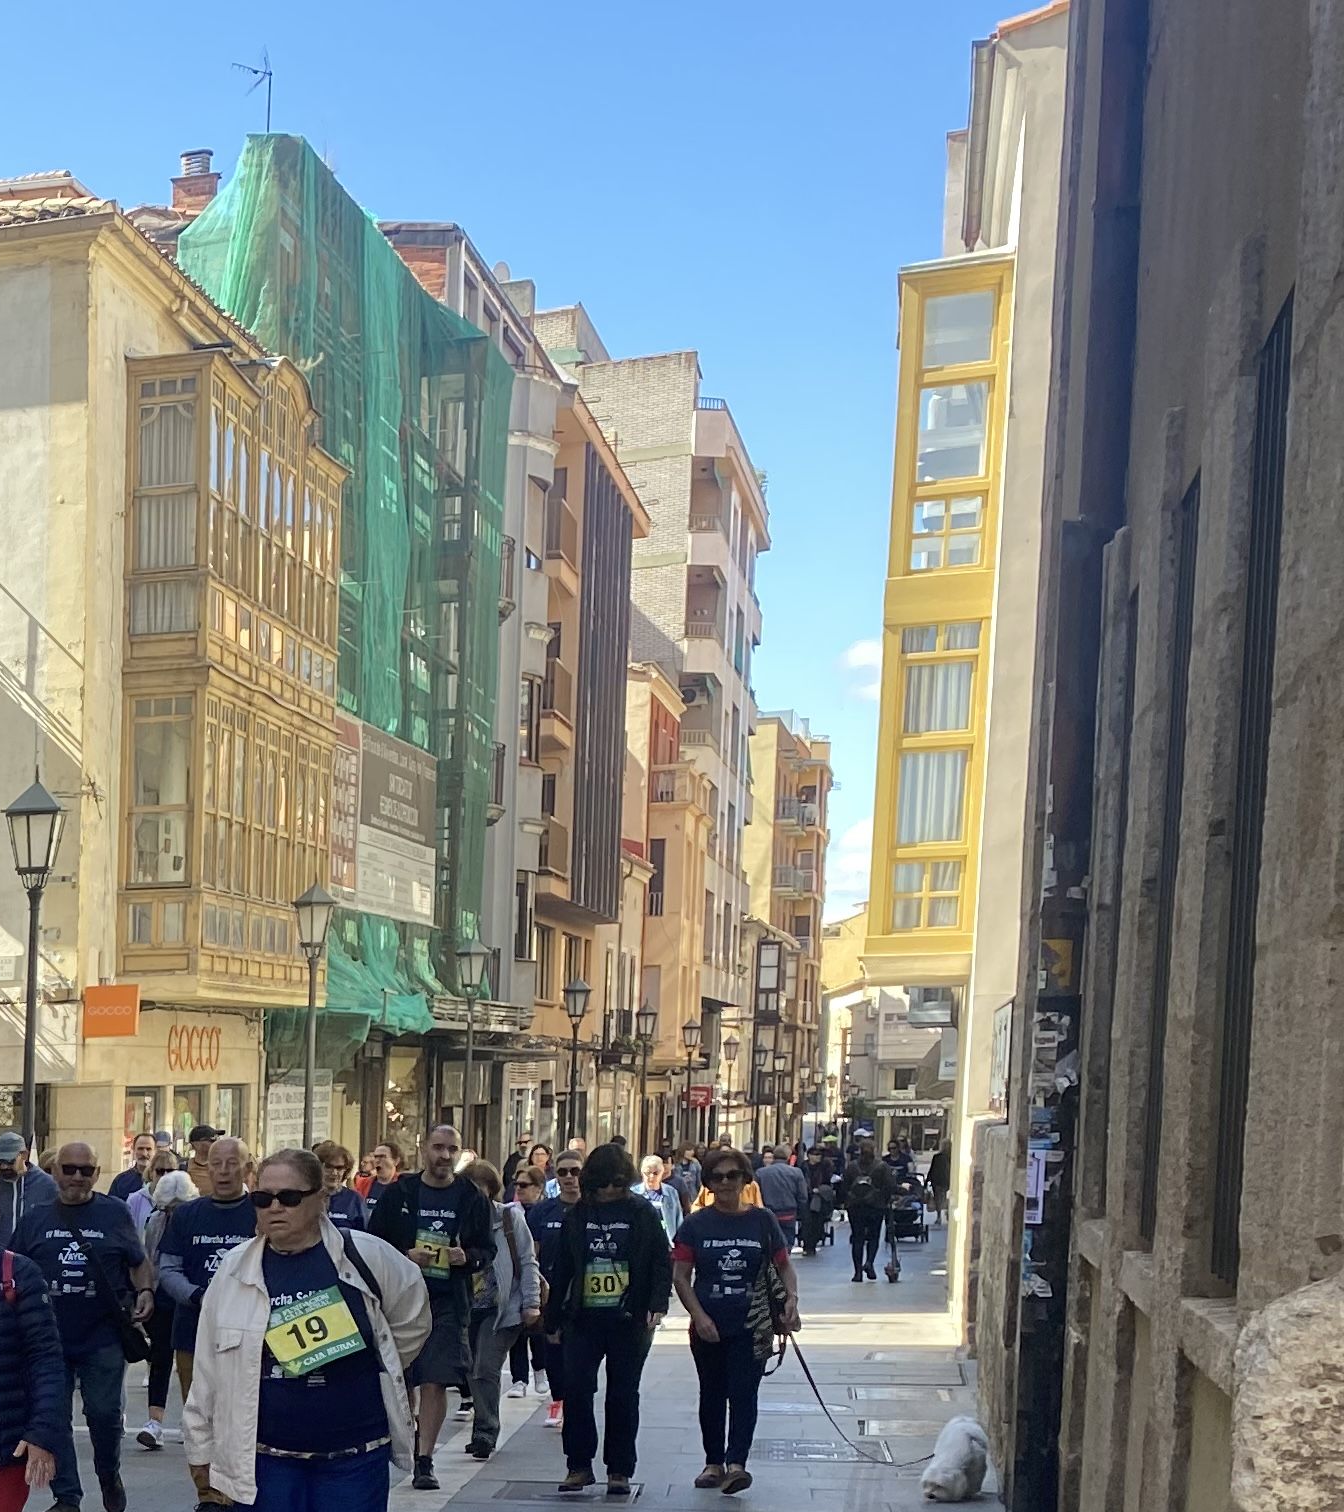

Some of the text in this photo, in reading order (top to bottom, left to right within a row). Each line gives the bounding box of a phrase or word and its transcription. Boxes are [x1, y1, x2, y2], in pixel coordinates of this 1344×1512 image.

[88, 1006, 132, 1015] GOCCO
[168, 1025, 220, 1071] GOCCO
[877, 1108, 930, 1117] SEVILLANO
[591, 1275, 615, 1293] 30
[271, 1293, 293, 1306] rcha
[287, 1316, 328, 1349] 19
[303, 1339, 359, 1366] CAJA RURAL
